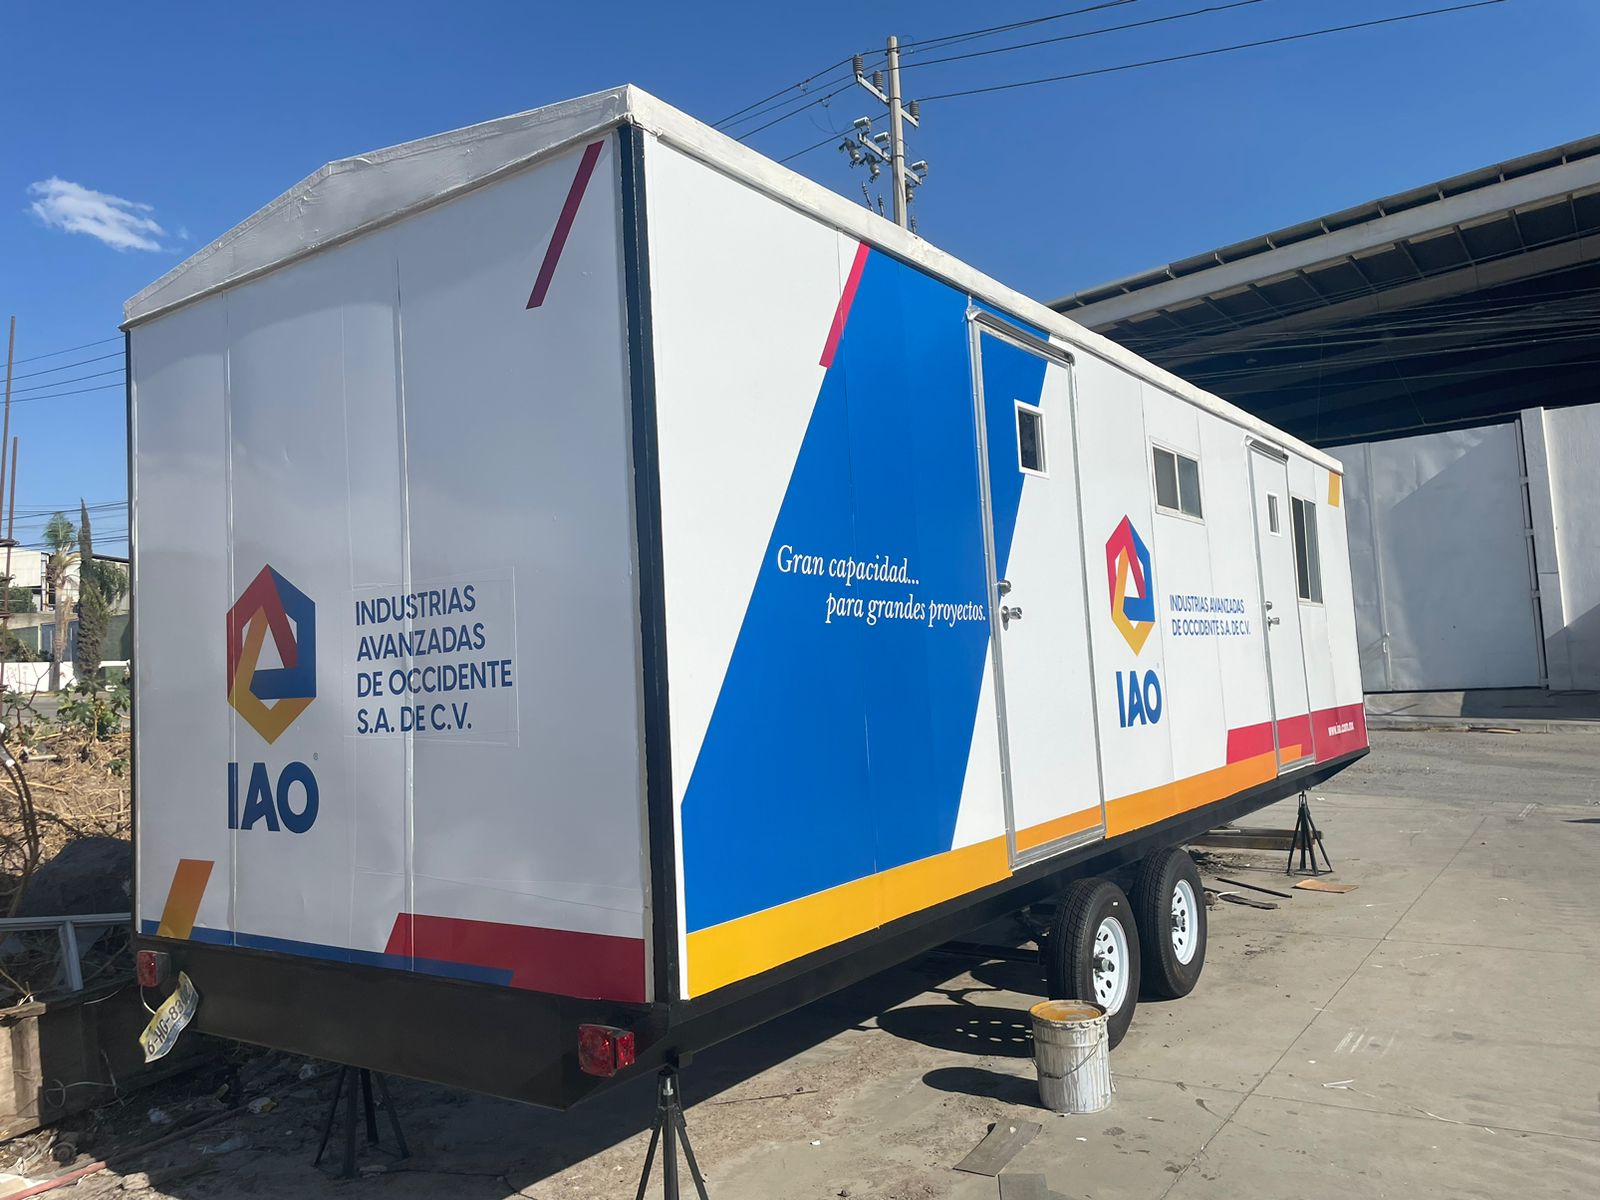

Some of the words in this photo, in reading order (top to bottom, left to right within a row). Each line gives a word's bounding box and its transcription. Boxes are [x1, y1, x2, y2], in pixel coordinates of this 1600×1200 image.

[777, 544, 825, 576] Gran
[828, 554, 920, 587] capacidad...
[355, 584, 476, 626] INDUSTRIAS
[824, 592, 864, 624] para
[866, 593, 926, 626] grandes
[927, 599, 986, 628] proyectos.
[1169, 594, 1208, 613] INDUSTRIAS
[1209, 596, 1245, 614] AVANZADAS
[356, 622, 486, 662] AVANZADAS
[1172, 619, 1182, 636] DE
[1182, 619, 1220, 636] OCCIDENTE
[1220, 620, 1231, 636] S.A.
[1231, 620, 1240, 636] DE
[357, 672, 383, 698] DE
[388, 659, 513, 695] OCCIDENTE
[357, 707, 395, 734] S.A.
[400, 704, 426, 732] DE
[431, 702, 472, 731] C.V.
[1115, 669, 1163, 728] IAO
[227, 761, 320, 834] IAO
